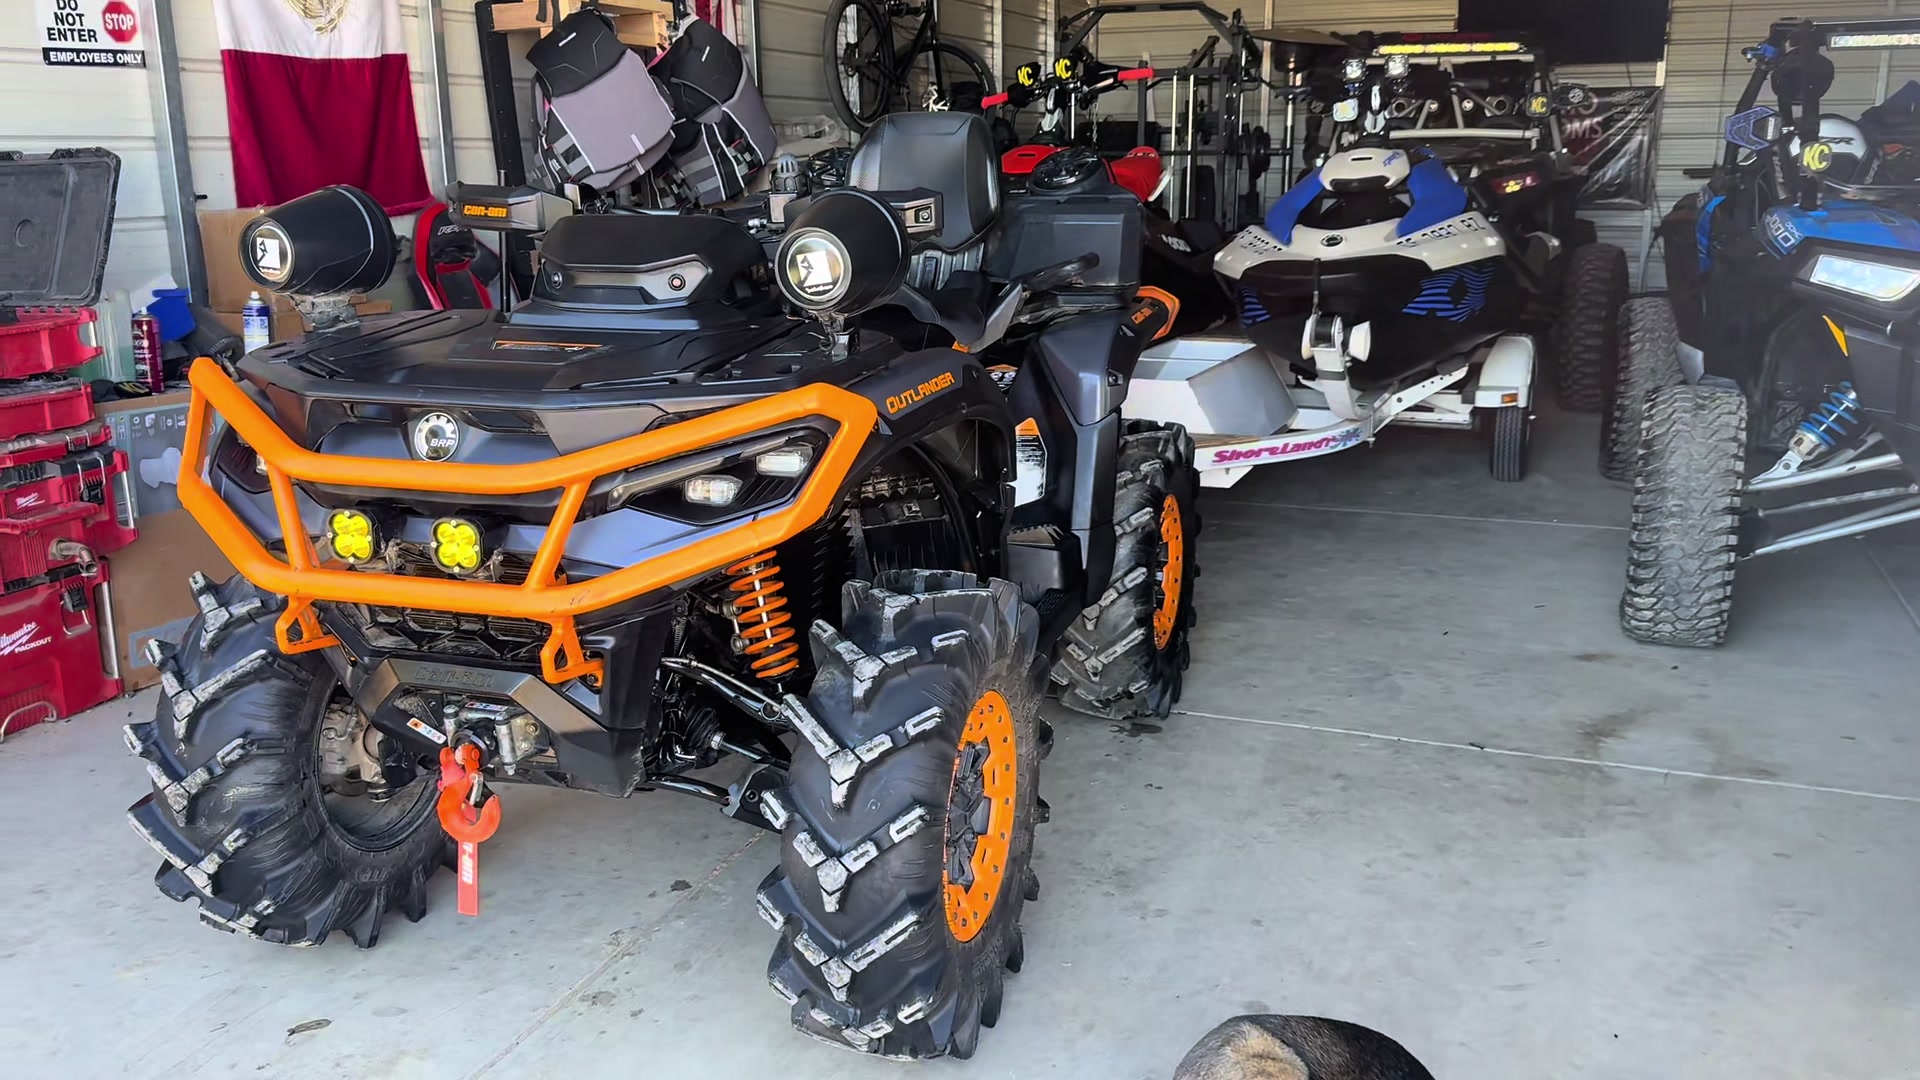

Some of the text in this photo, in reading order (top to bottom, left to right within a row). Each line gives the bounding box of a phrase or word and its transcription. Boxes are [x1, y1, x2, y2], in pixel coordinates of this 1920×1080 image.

[56, 0, 78, 11] DO
[53, 12, 85, 27] NOT
[105, 13, 134, 31] STOP
[46, 27, 98, 43] ENTER
[49, 51, 142, 64] EMPLOYEES ONLY
[1017, 66, 1033, 86] KC
[1055, 58, 1072, 79] KC
[1531, 96, 1547, 113] KC
[1803, 143, 1829, 170] KC
[463, 204, 507, 217] can-am
[430, 438, 456, 448] BRP
[0, 621, 38, 649] ilwaukee
[14, 635, 52, 654] PACKOUT
